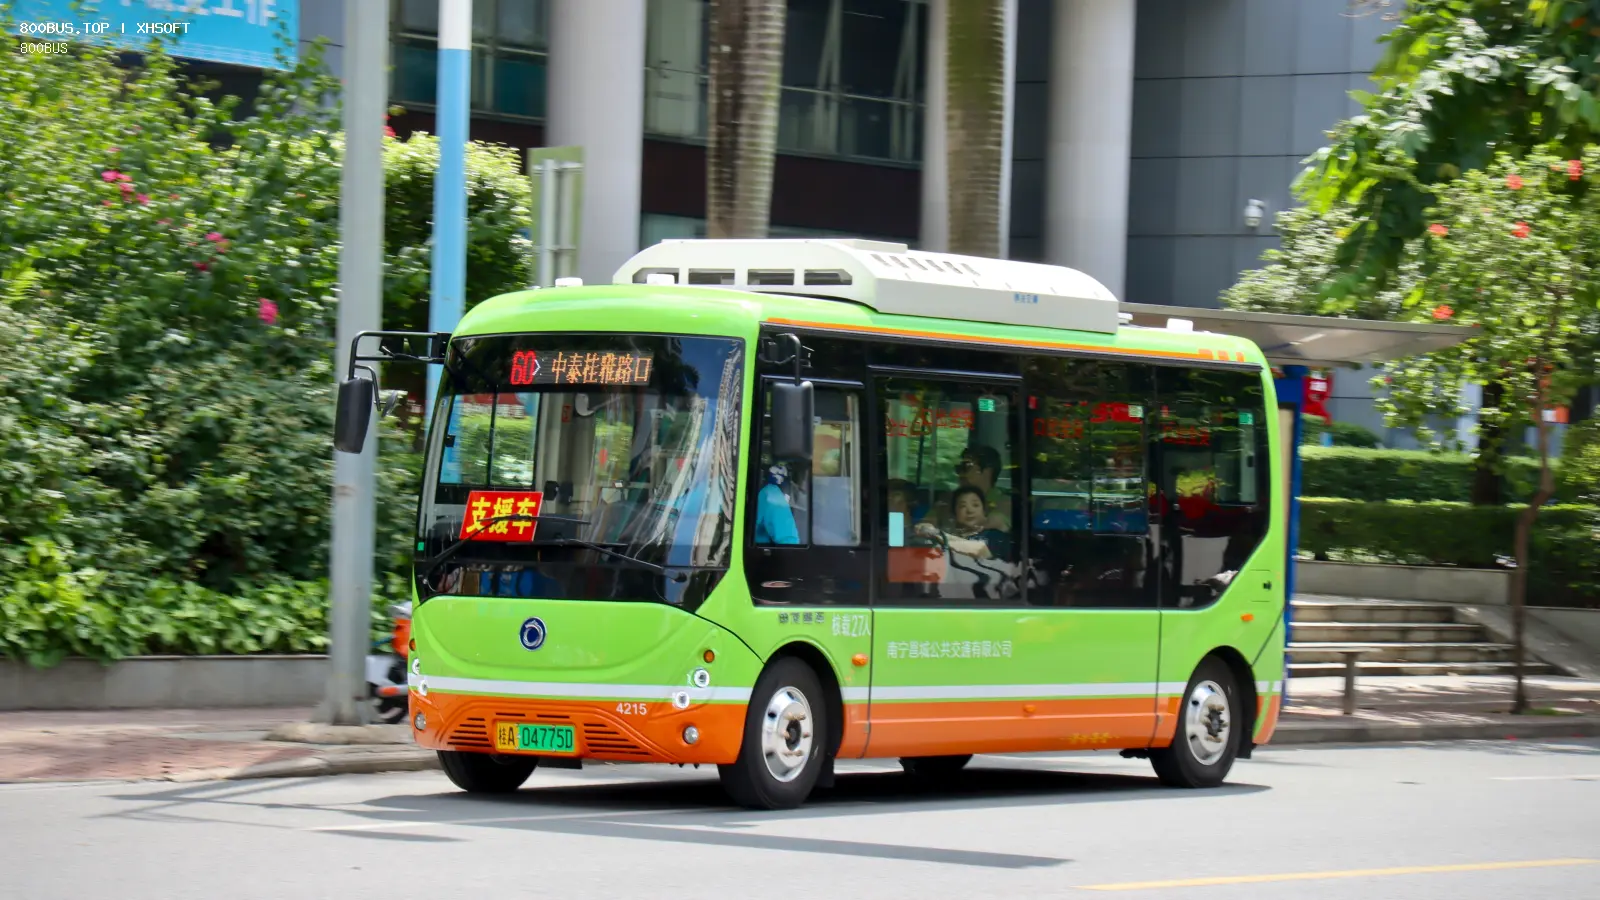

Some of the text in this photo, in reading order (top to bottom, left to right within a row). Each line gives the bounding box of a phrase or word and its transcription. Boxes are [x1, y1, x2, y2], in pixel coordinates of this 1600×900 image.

[510, 350, 536, 385] 60
[465, 496, 536, 535] 支援车
[616, 702, 648, 716] 4215
